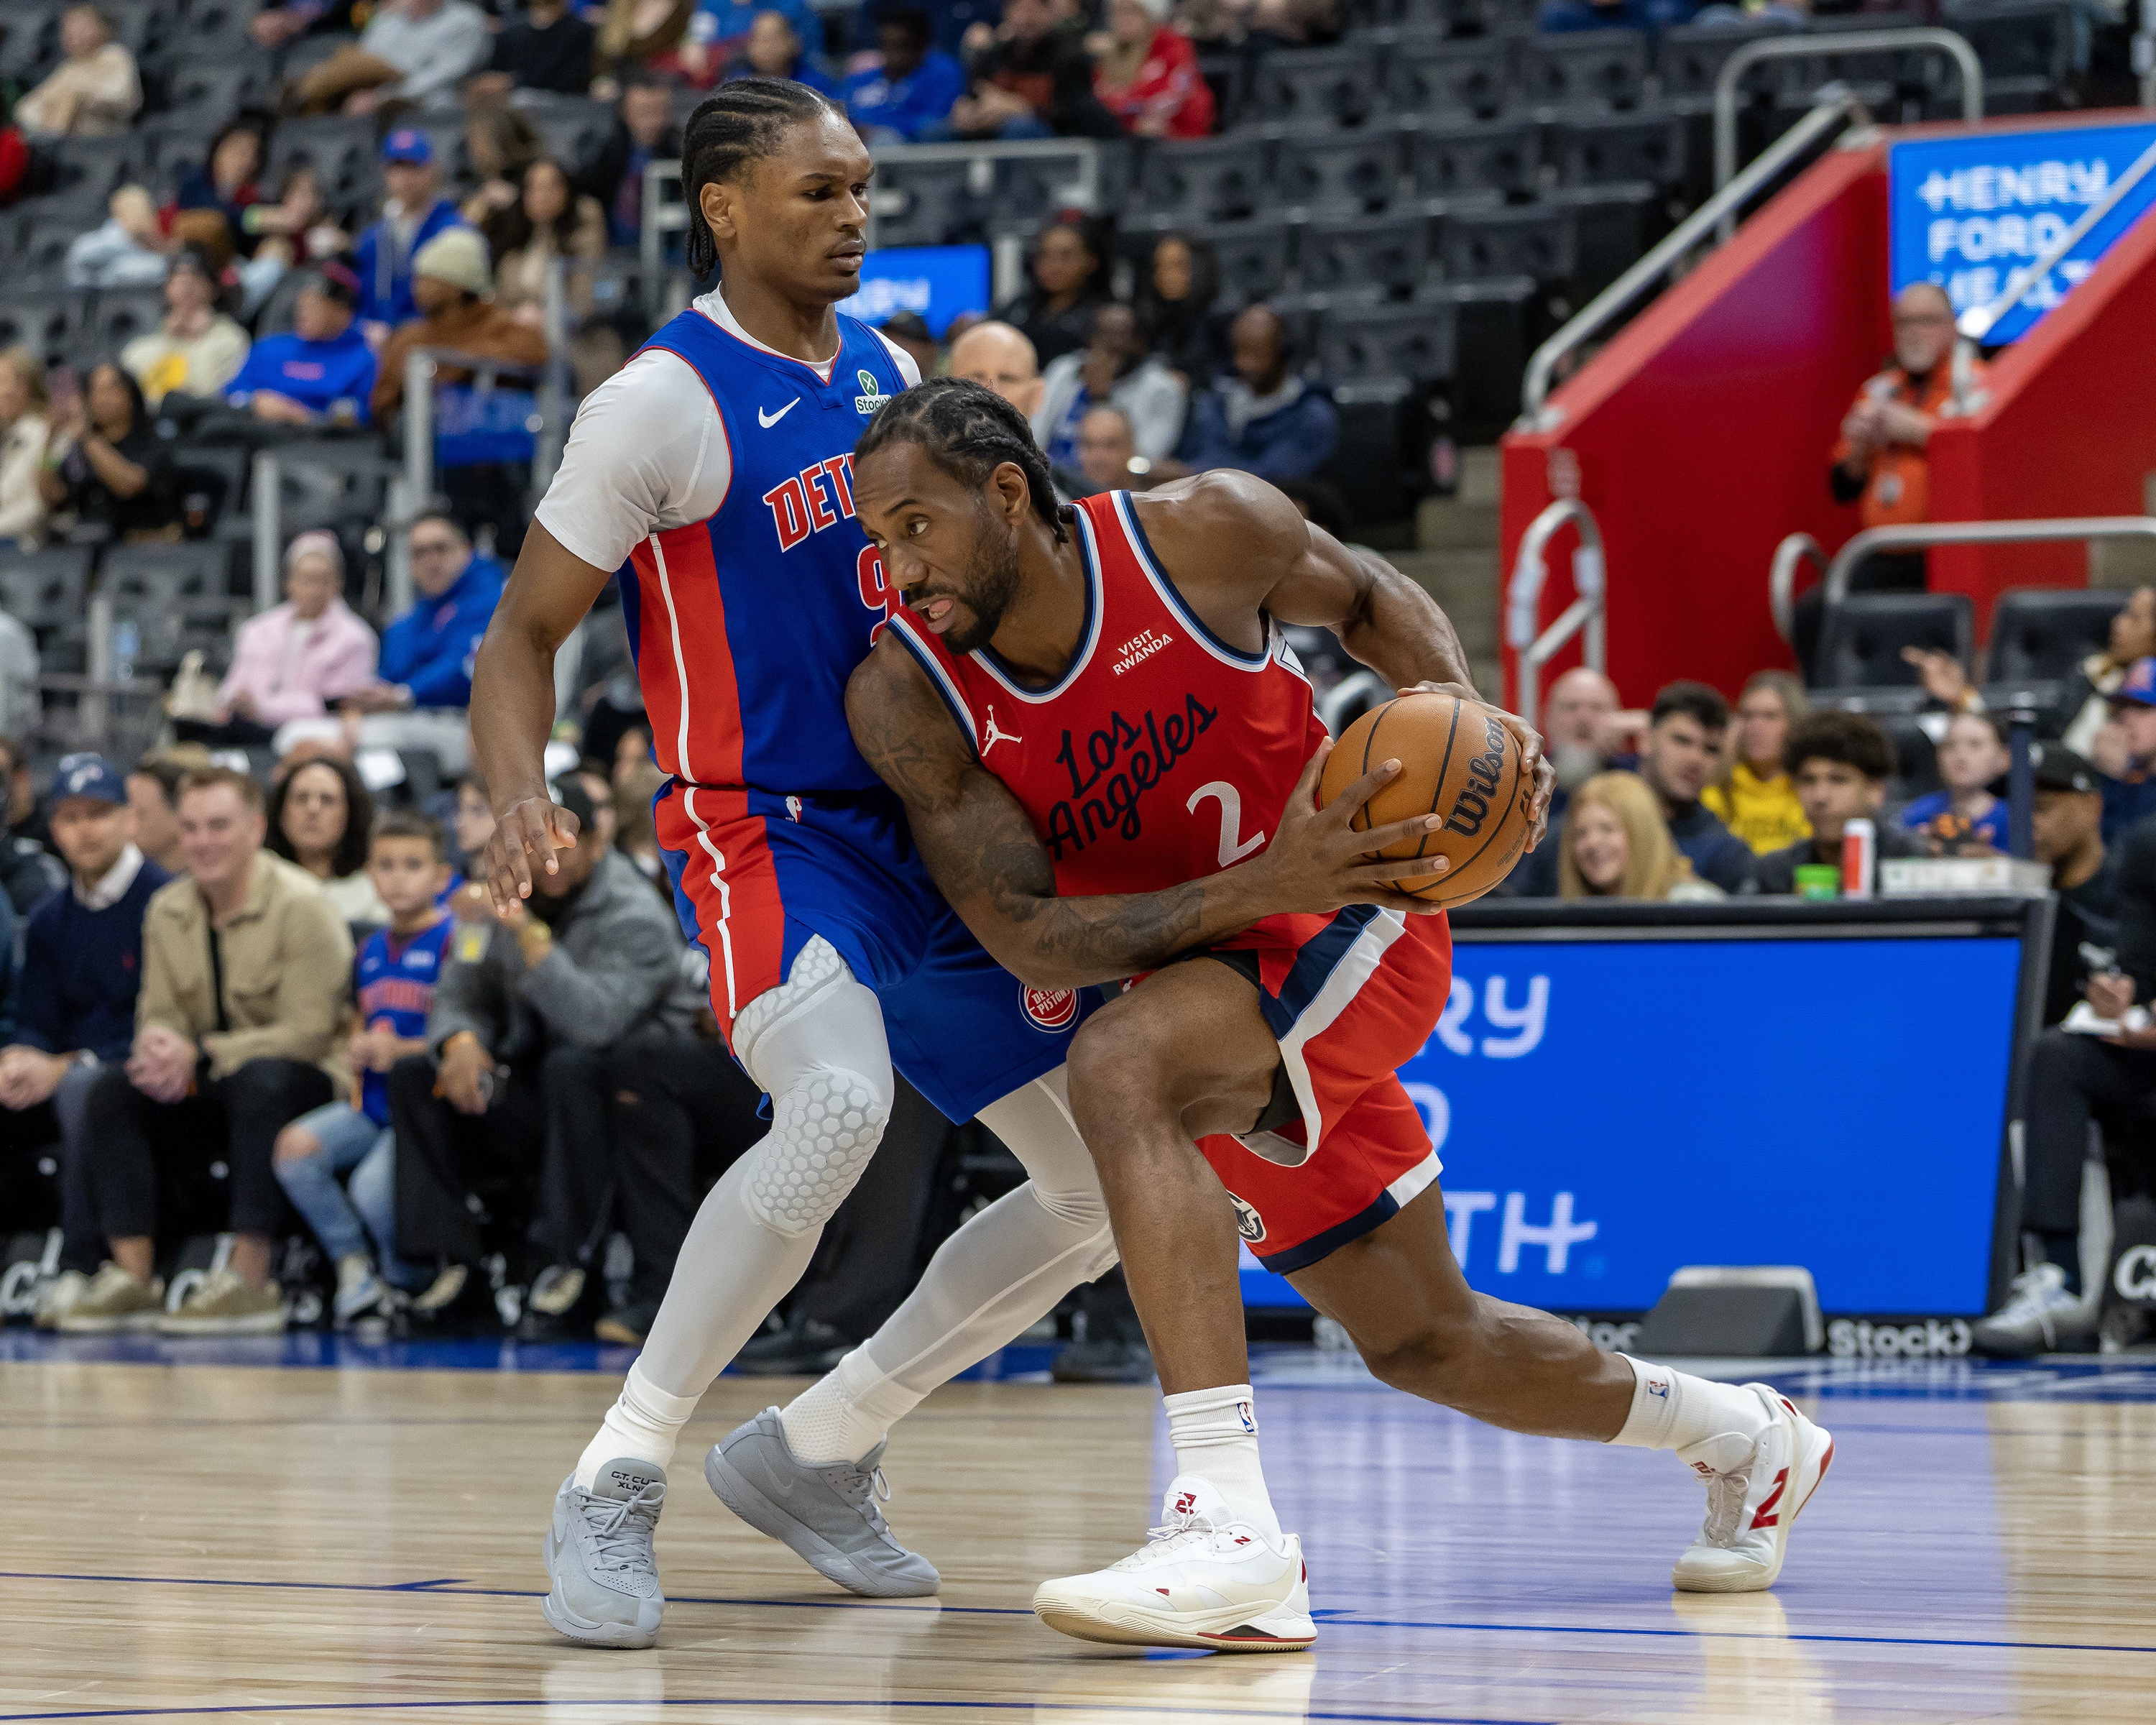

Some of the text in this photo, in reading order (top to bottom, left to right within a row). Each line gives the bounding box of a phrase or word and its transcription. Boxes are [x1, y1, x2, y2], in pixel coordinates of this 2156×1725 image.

[1928, 213, 2073, 263] FORD
[763, 452, 856, 553] DET
[1112, 633, 1174, 676] RWANDA
[1118, 629, 1153, 656] VISIT
[1046, 693, 1219, 862] Angeles
[1055, 710, 1143, 800] Los
[1442, 716, 1506, 838] Wilson
[1186, 781, 1266, 868] 2
[611, 1471, 630, 1481] G.T.
[617, 1481, 645, 1492] XLN
